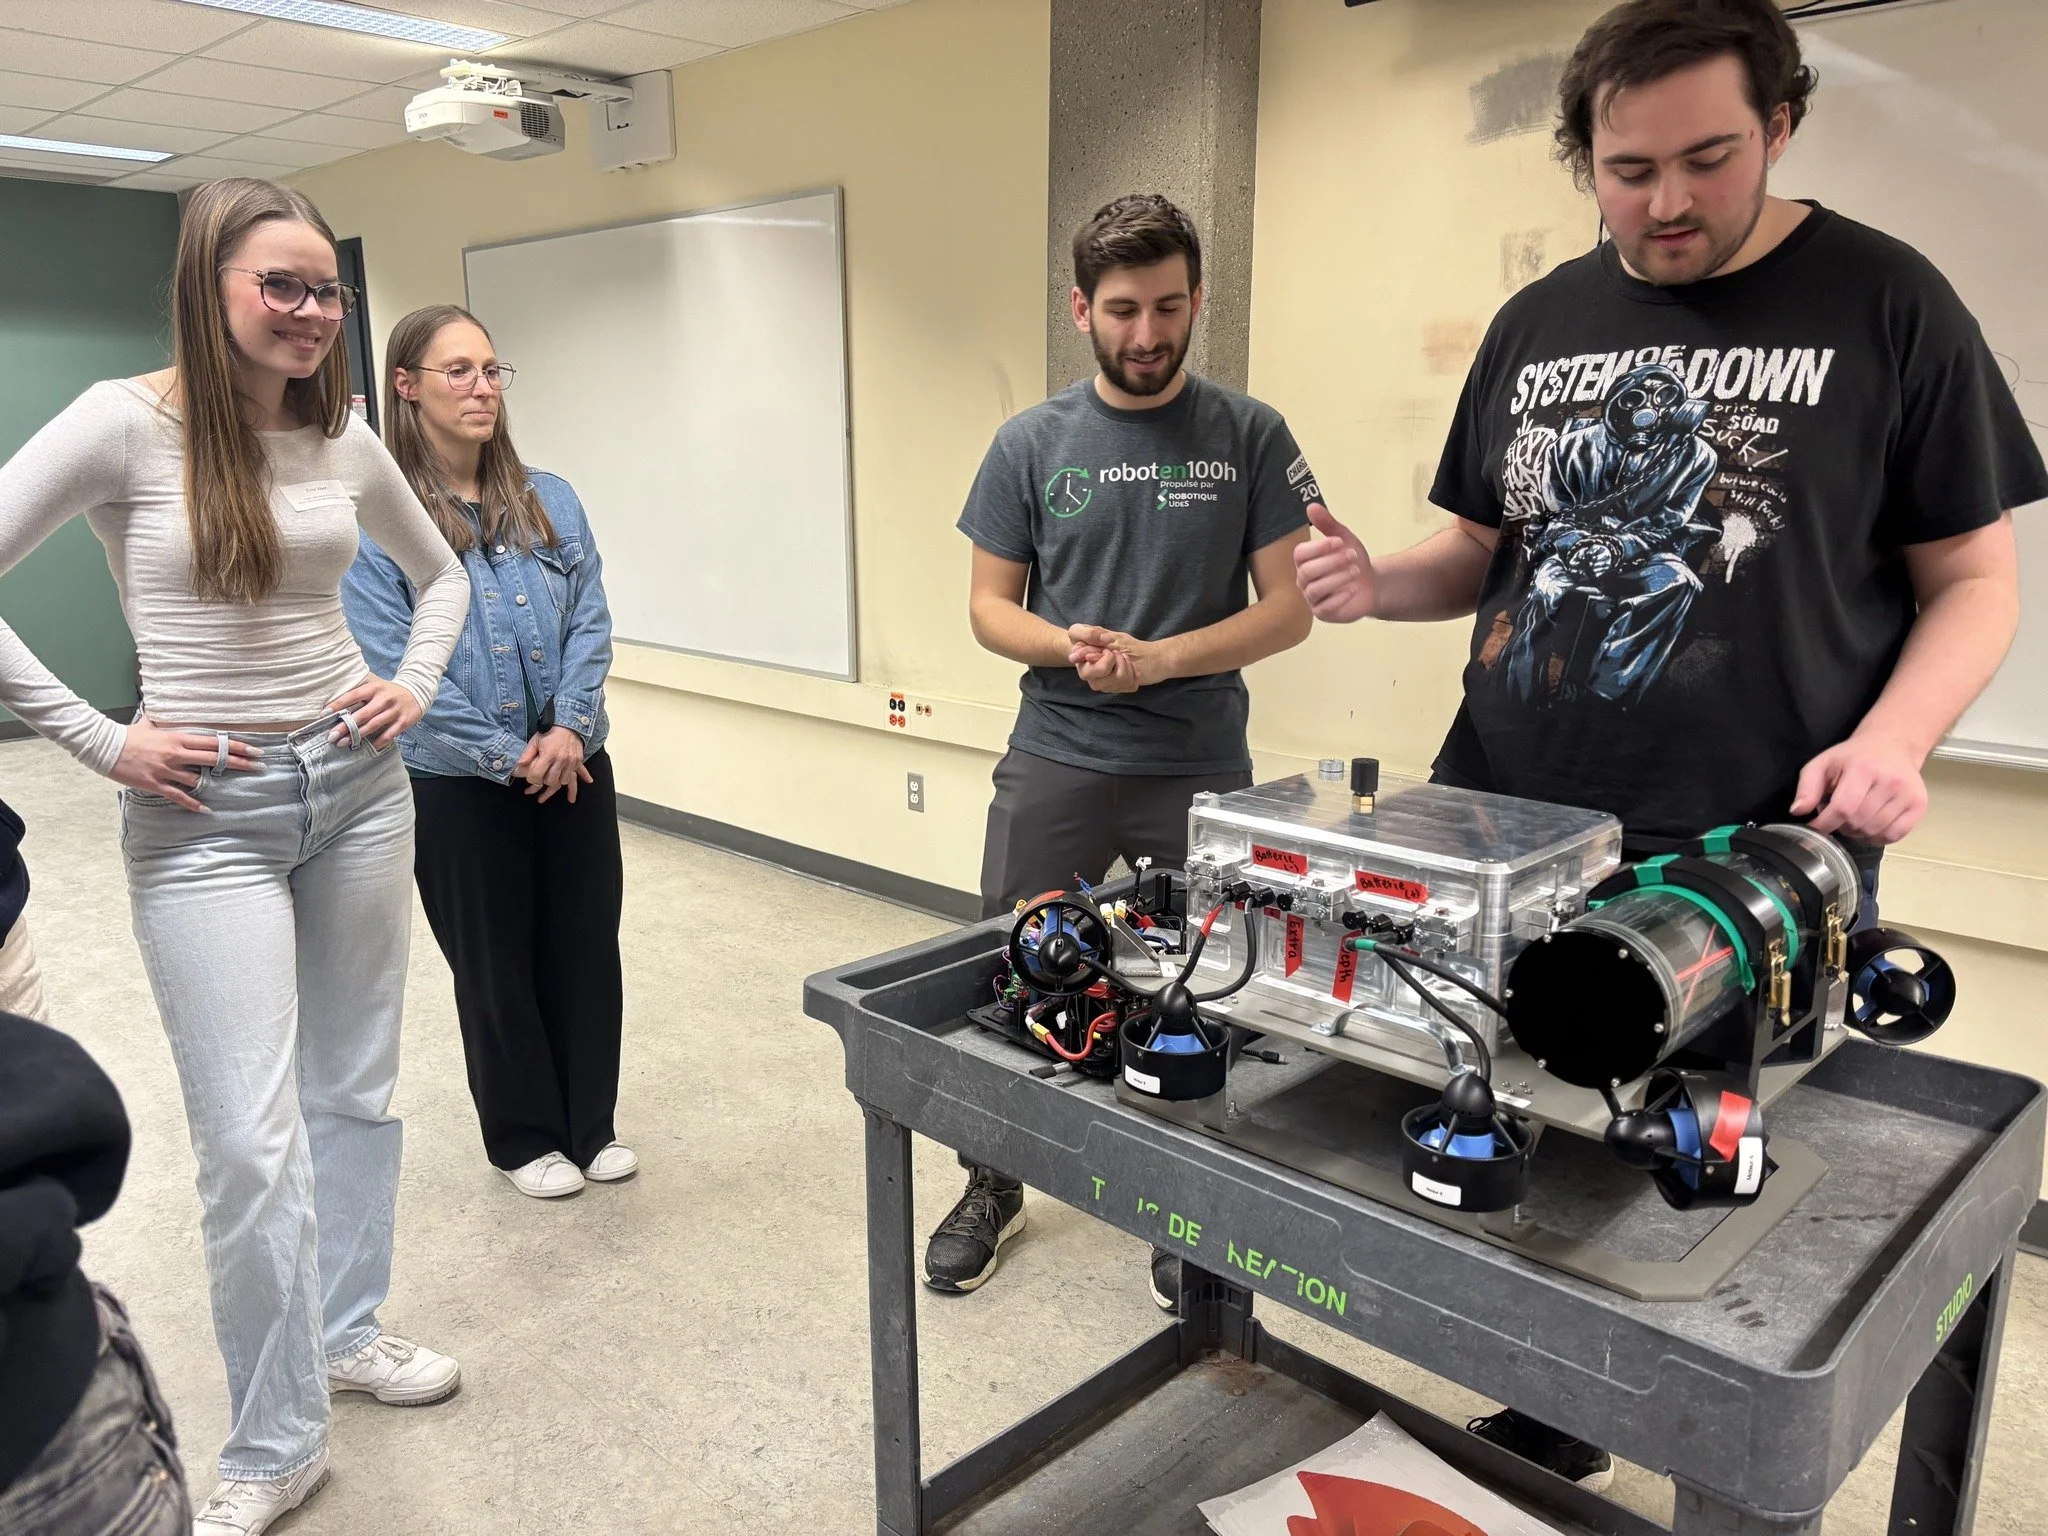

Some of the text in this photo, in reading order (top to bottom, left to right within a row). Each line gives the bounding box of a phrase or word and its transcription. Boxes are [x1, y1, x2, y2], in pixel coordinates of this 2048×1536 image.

[1510, 350, 1634, 414] SYSTEM
[1684, 347, 1836, 406] DOWN
[1727, 416, 1780, 434] SOAD
[1168, 493, 1217, 501] ROBOTIQUE
[1200, 481, 1215, 489] par
[1360, 877, 1405, 890] Batterie
[1289, 921, 1300, 958] Extra
[1168, 1213, 1201, 1246] DE
[1936, 1272, 1972, 1342] STUDIO
